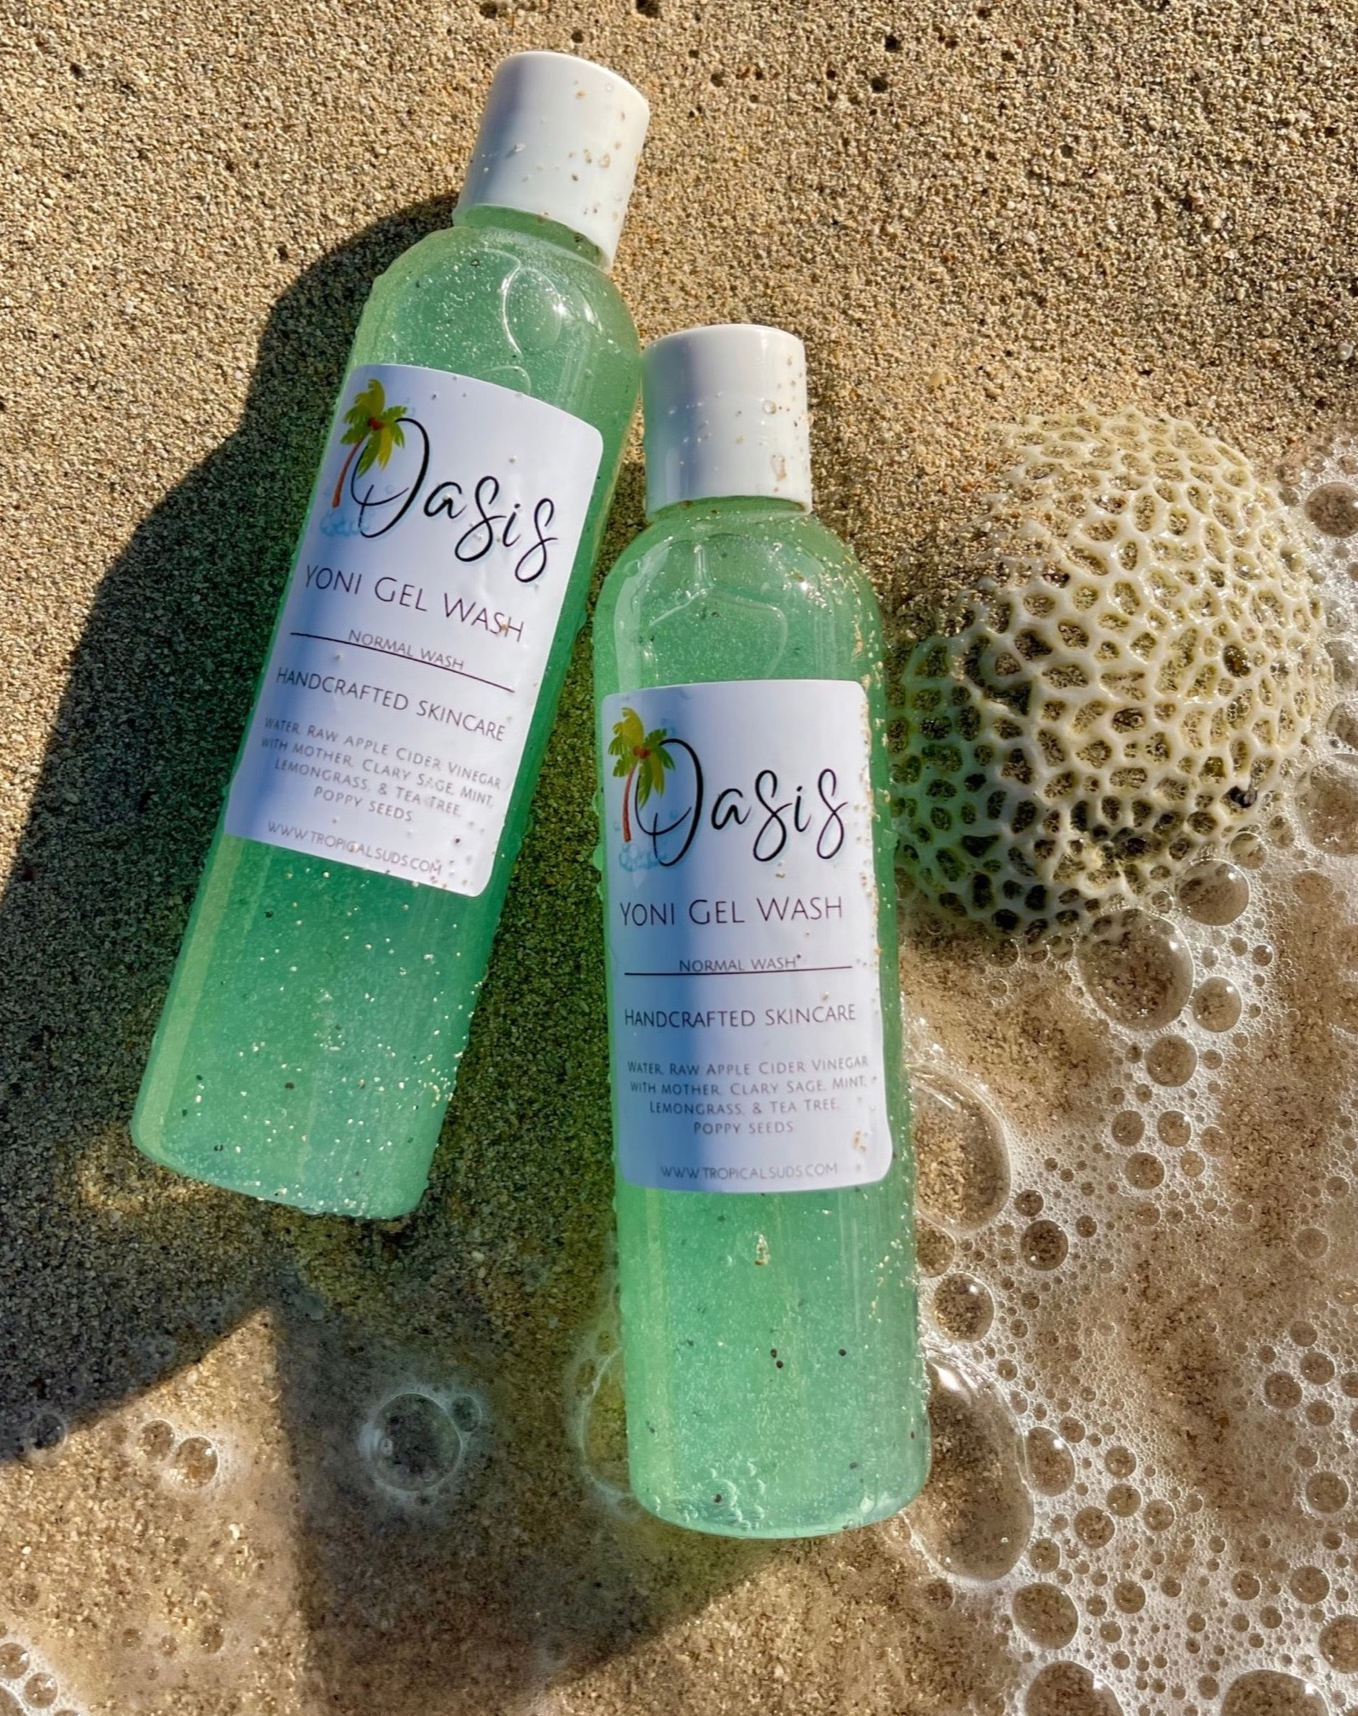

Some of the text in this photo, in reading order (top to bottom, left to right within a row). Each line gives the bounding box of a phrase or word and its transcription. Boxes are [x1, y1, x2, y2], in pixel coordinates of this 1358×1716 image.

[350, 417, 559, 583] Oasis
[304, 563, 526, 643] YONI GEL WASH
[347, 628, 465, 670] NORMAL WASH
[275, 667, 506, 742] HANDCRAFTED SKINCARE
[261, 738, 288, 752] WITH
[361, 758, 411, 781] CLARY
[306, 724, 339, 742] RAW
[343, 735, 389, 756] APPLE
[395, 747, 441, 771] CIDER
[447, 761, 502, 790] VINEGAR
[313, 785, 414, 822] POPPY SEEDS
[377, 782, 388, 795] &
[394, 785, 421, 804] TEA
[634, 738, 848, 867] Oasis
[620, 896, 843, 926] YONI GEL WASH
[679, 957, 797, 973] NORMAL WASH
[624, 1003, 856, 1028] HANDCRAFTED SKINCARE
[669, 1062, 700, 1076] RAW
[706, 1062, 751, 1076] APPLE
[758, 1060, 806, 1075] CIDER
[811, 1055, 869, 1071] VINEGAR
[630, 1081, 657, 1094] WITH
[729, 1082, 779, 1096] CLARY
[752, 1101, 763, 1115] &
[770, 1101, 798, 1114] TEA
[693, 1121, 795, 1136] POPPY SEEDS
